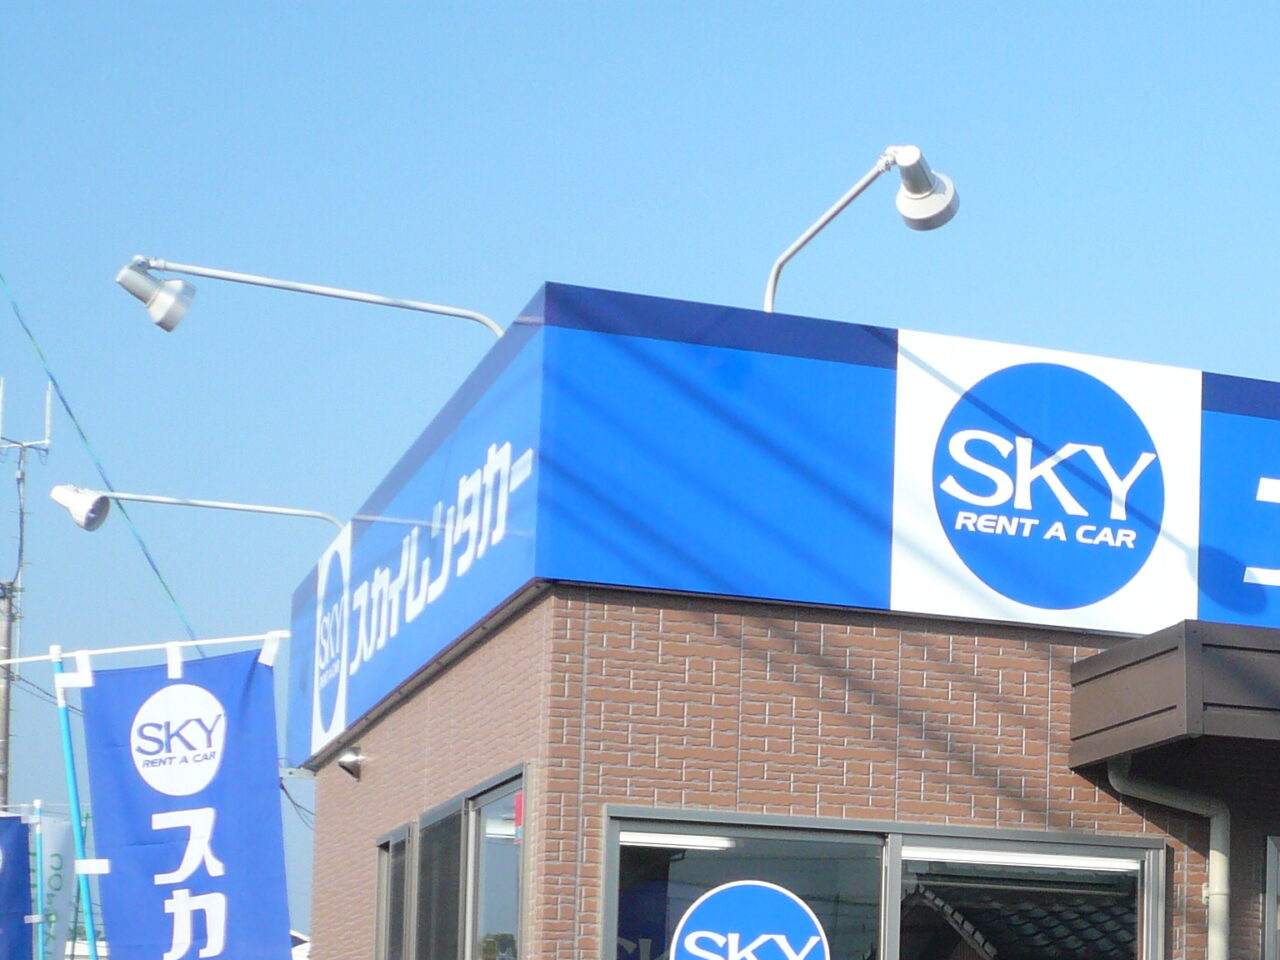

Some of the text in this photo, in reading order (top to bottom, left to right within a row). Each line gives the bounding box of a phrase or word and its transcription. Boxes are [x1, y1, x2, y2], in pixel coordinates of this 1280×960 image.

[940, 429, 1157, 521] SKY
[954, 510, 1137, 549] RENT A CAR
[350, 441, 533, 676] スカイレンタカー
[136, 714, 223, 756] SKY
[142, 751, 217, 769] RENT A CAR
